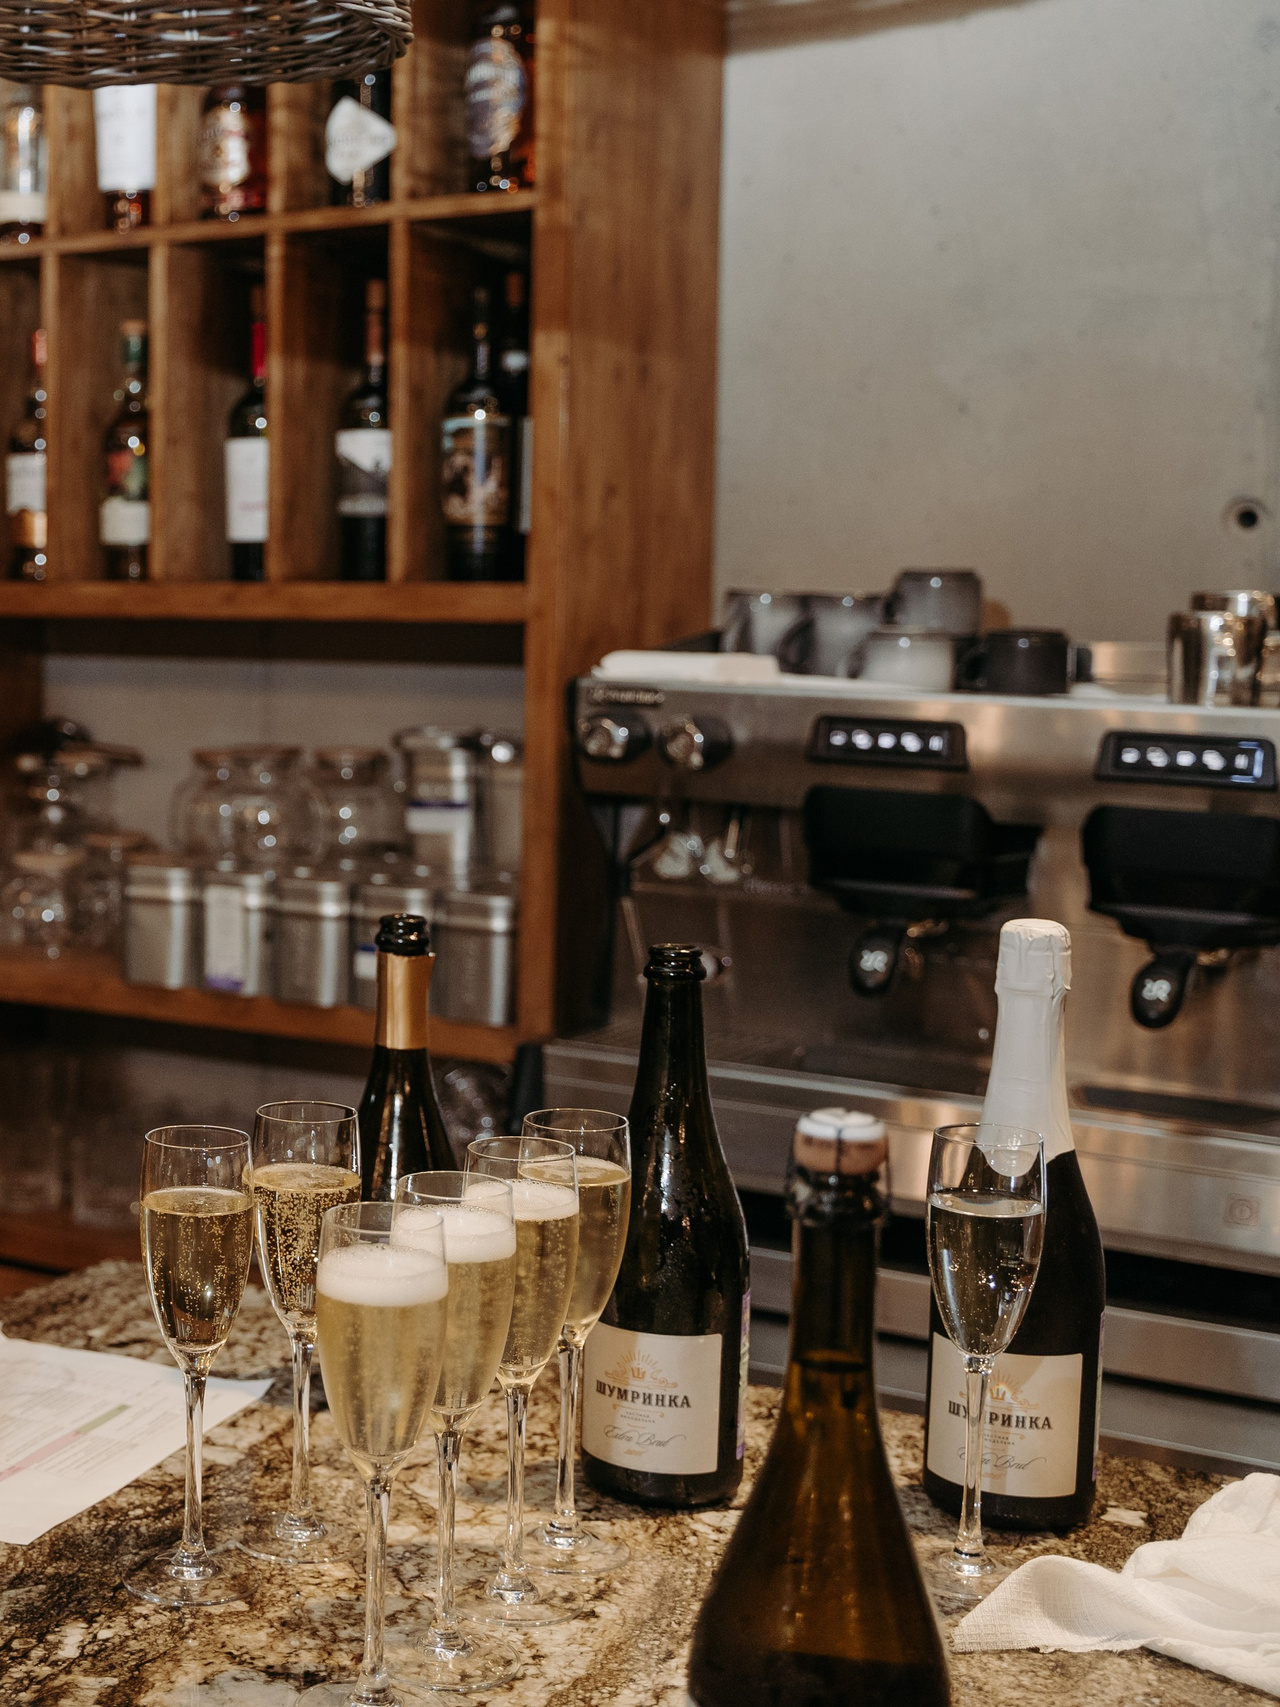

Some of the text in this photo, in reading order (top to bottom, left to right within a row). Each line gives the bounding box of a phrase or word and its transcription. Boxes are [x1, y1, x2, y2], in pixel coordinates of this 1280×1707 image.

[596, 1380, 691, 1408] ШУМРИНКА
[948, 1400, 1052, 1430] ШУРИНКА
[604, 1424, 686, 1448] Extra Brut
